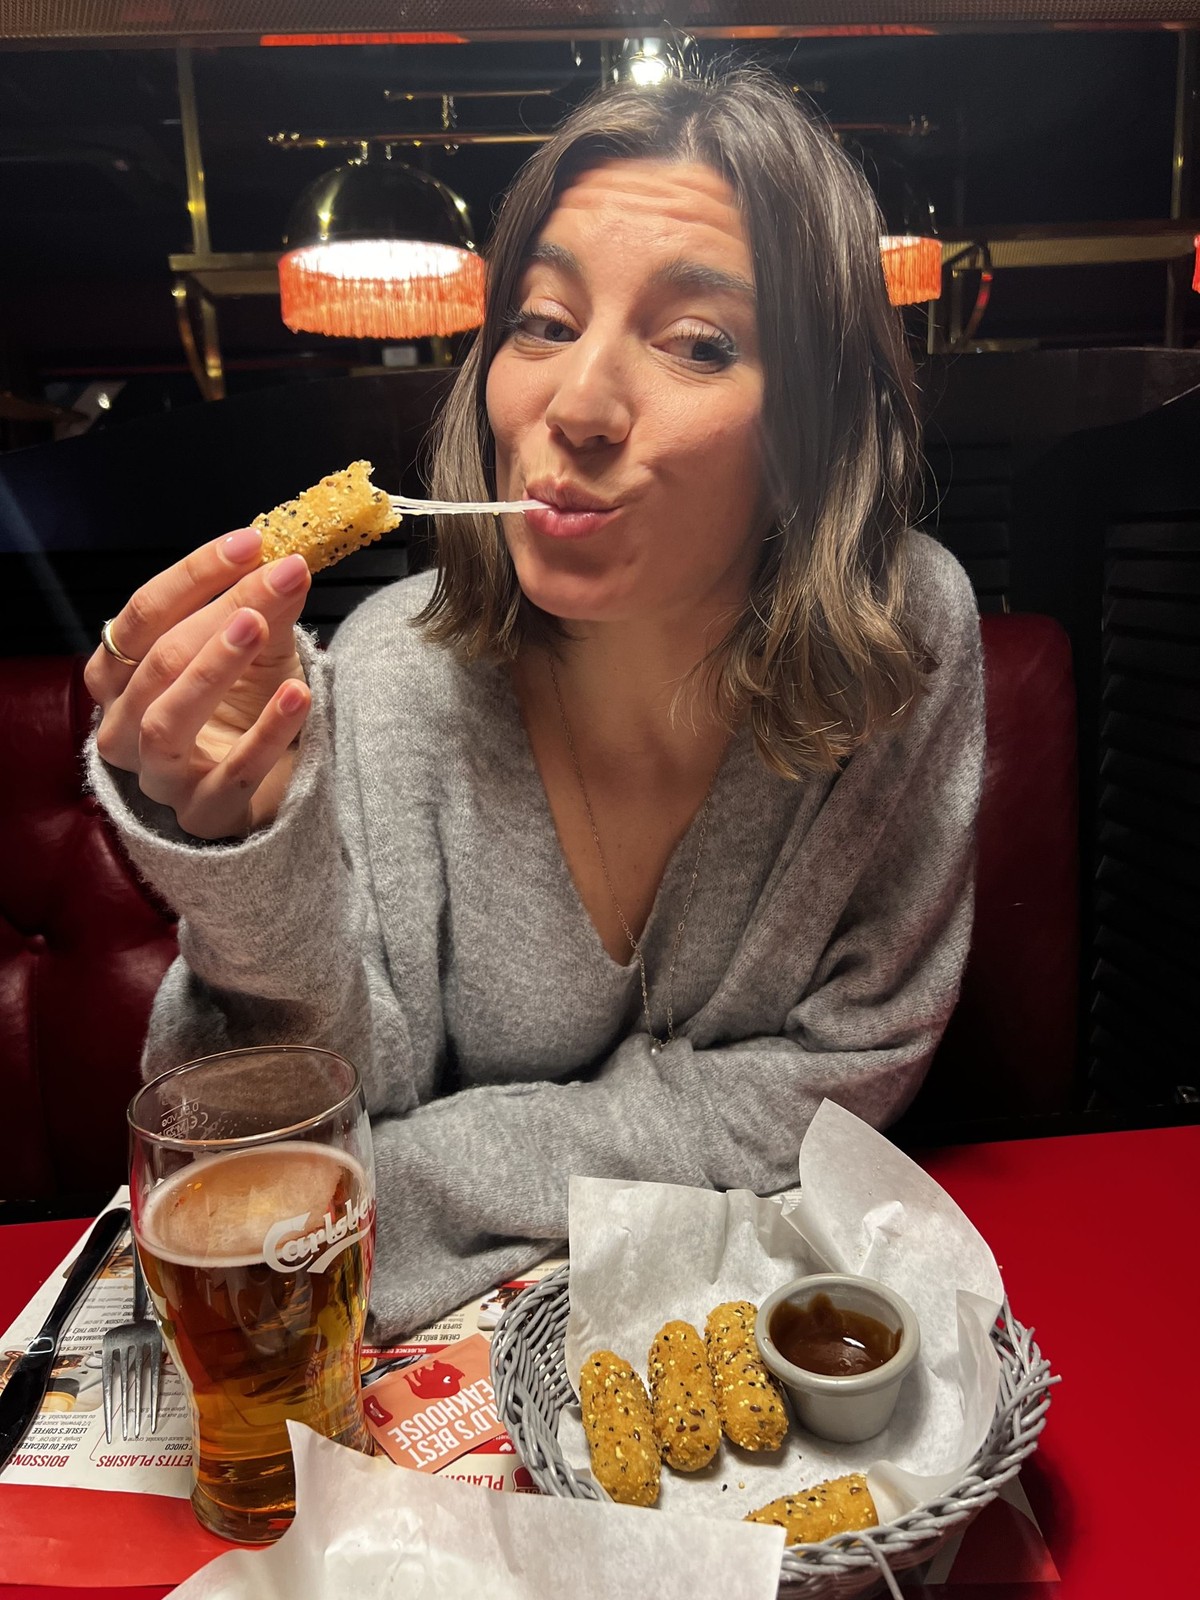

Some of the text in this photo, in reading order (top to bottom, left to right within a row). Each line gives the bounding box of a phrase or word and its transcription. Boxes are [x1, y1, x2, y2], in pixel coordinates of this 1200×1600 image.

[414, 1333, 460, 1342] CRÈME BRÛLÉE
[387, 1378, 495, 1451] EAKHOUSE
[32, 1427, 88, 1435] LESLIE'S COFFEE
[59, 1443, 78, 1451] CAFÉ
[164, 1443, 189, 1451] CHOCO
[407, 1427, 460, 1469] BEST
[96, 1454, 193, 1467] ETITS PLAISIRS
